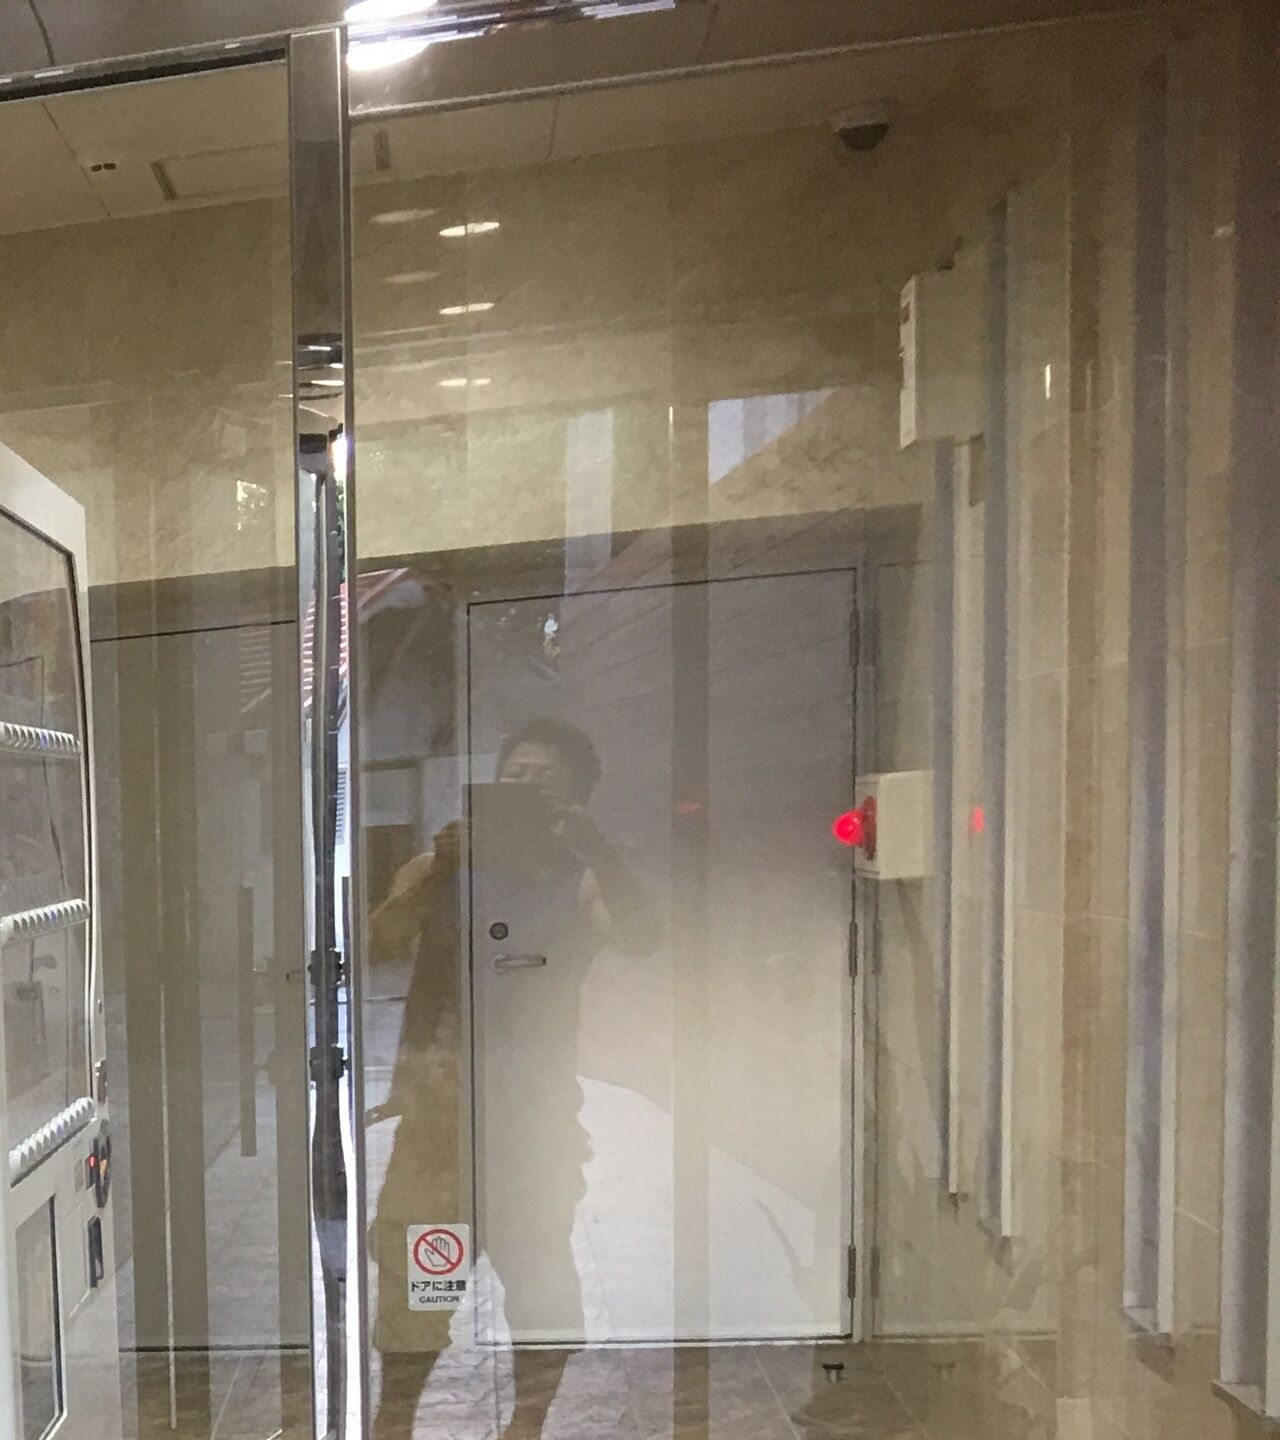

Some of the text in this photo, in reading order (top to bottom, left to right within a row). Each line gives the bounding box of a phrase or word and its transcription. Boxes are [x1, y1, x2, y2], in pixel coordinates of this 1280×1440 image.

[411, 1280, 467, 1292] ドアに注意
[418, 1295, 460, 1304] CAUTION
